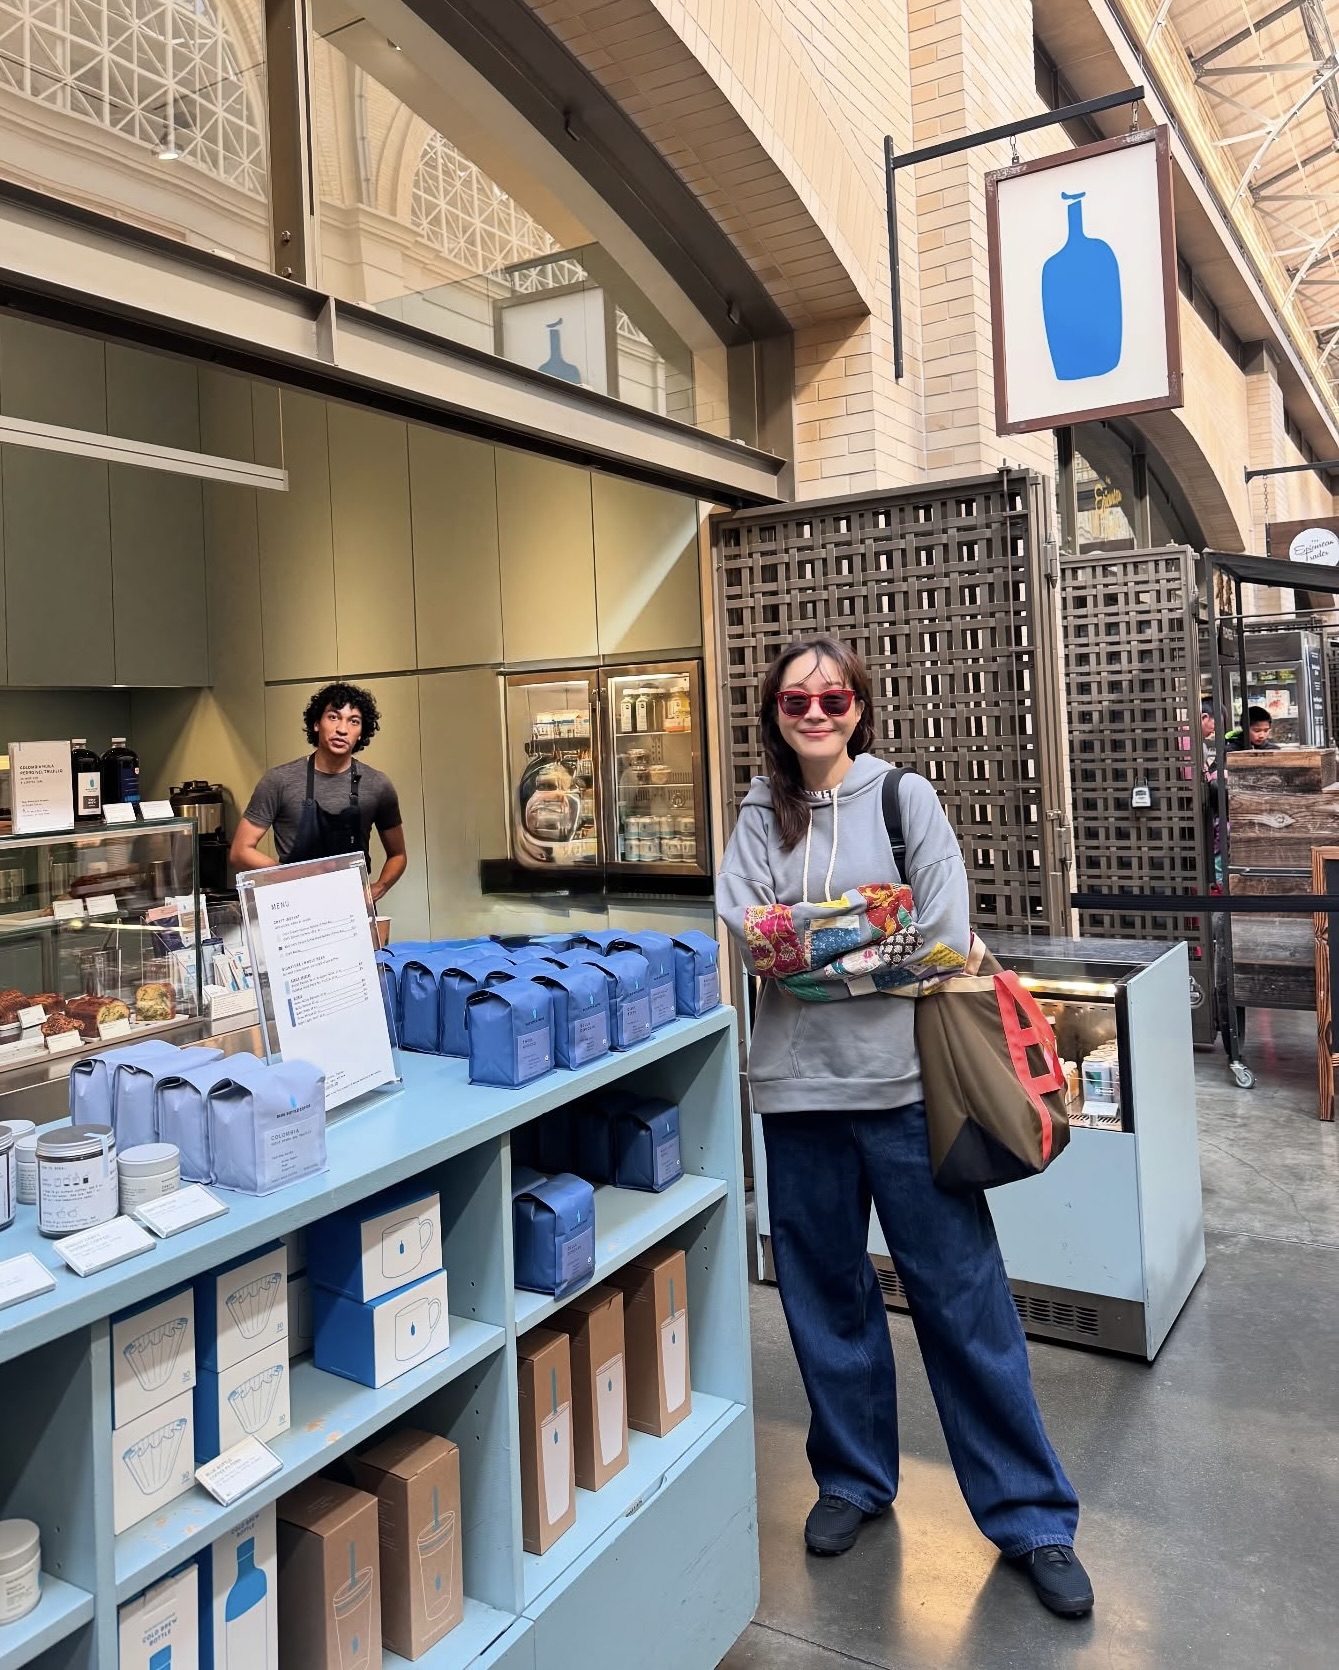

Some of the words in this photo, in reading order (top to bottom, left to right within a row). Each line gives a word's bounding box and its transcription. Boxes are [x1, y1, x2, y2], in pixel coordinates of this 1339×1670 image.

[1294, 541, 1334, 556] Epicurean
[271, 900, 290, 910] MENU
[271, 1128, 300, 1140] COLOMBIA
[142, 1630, 159, 1643] COLD
[160, 1616, 178, 1632] BREW
[150, 1629, 171, 1646] BOTTLE
